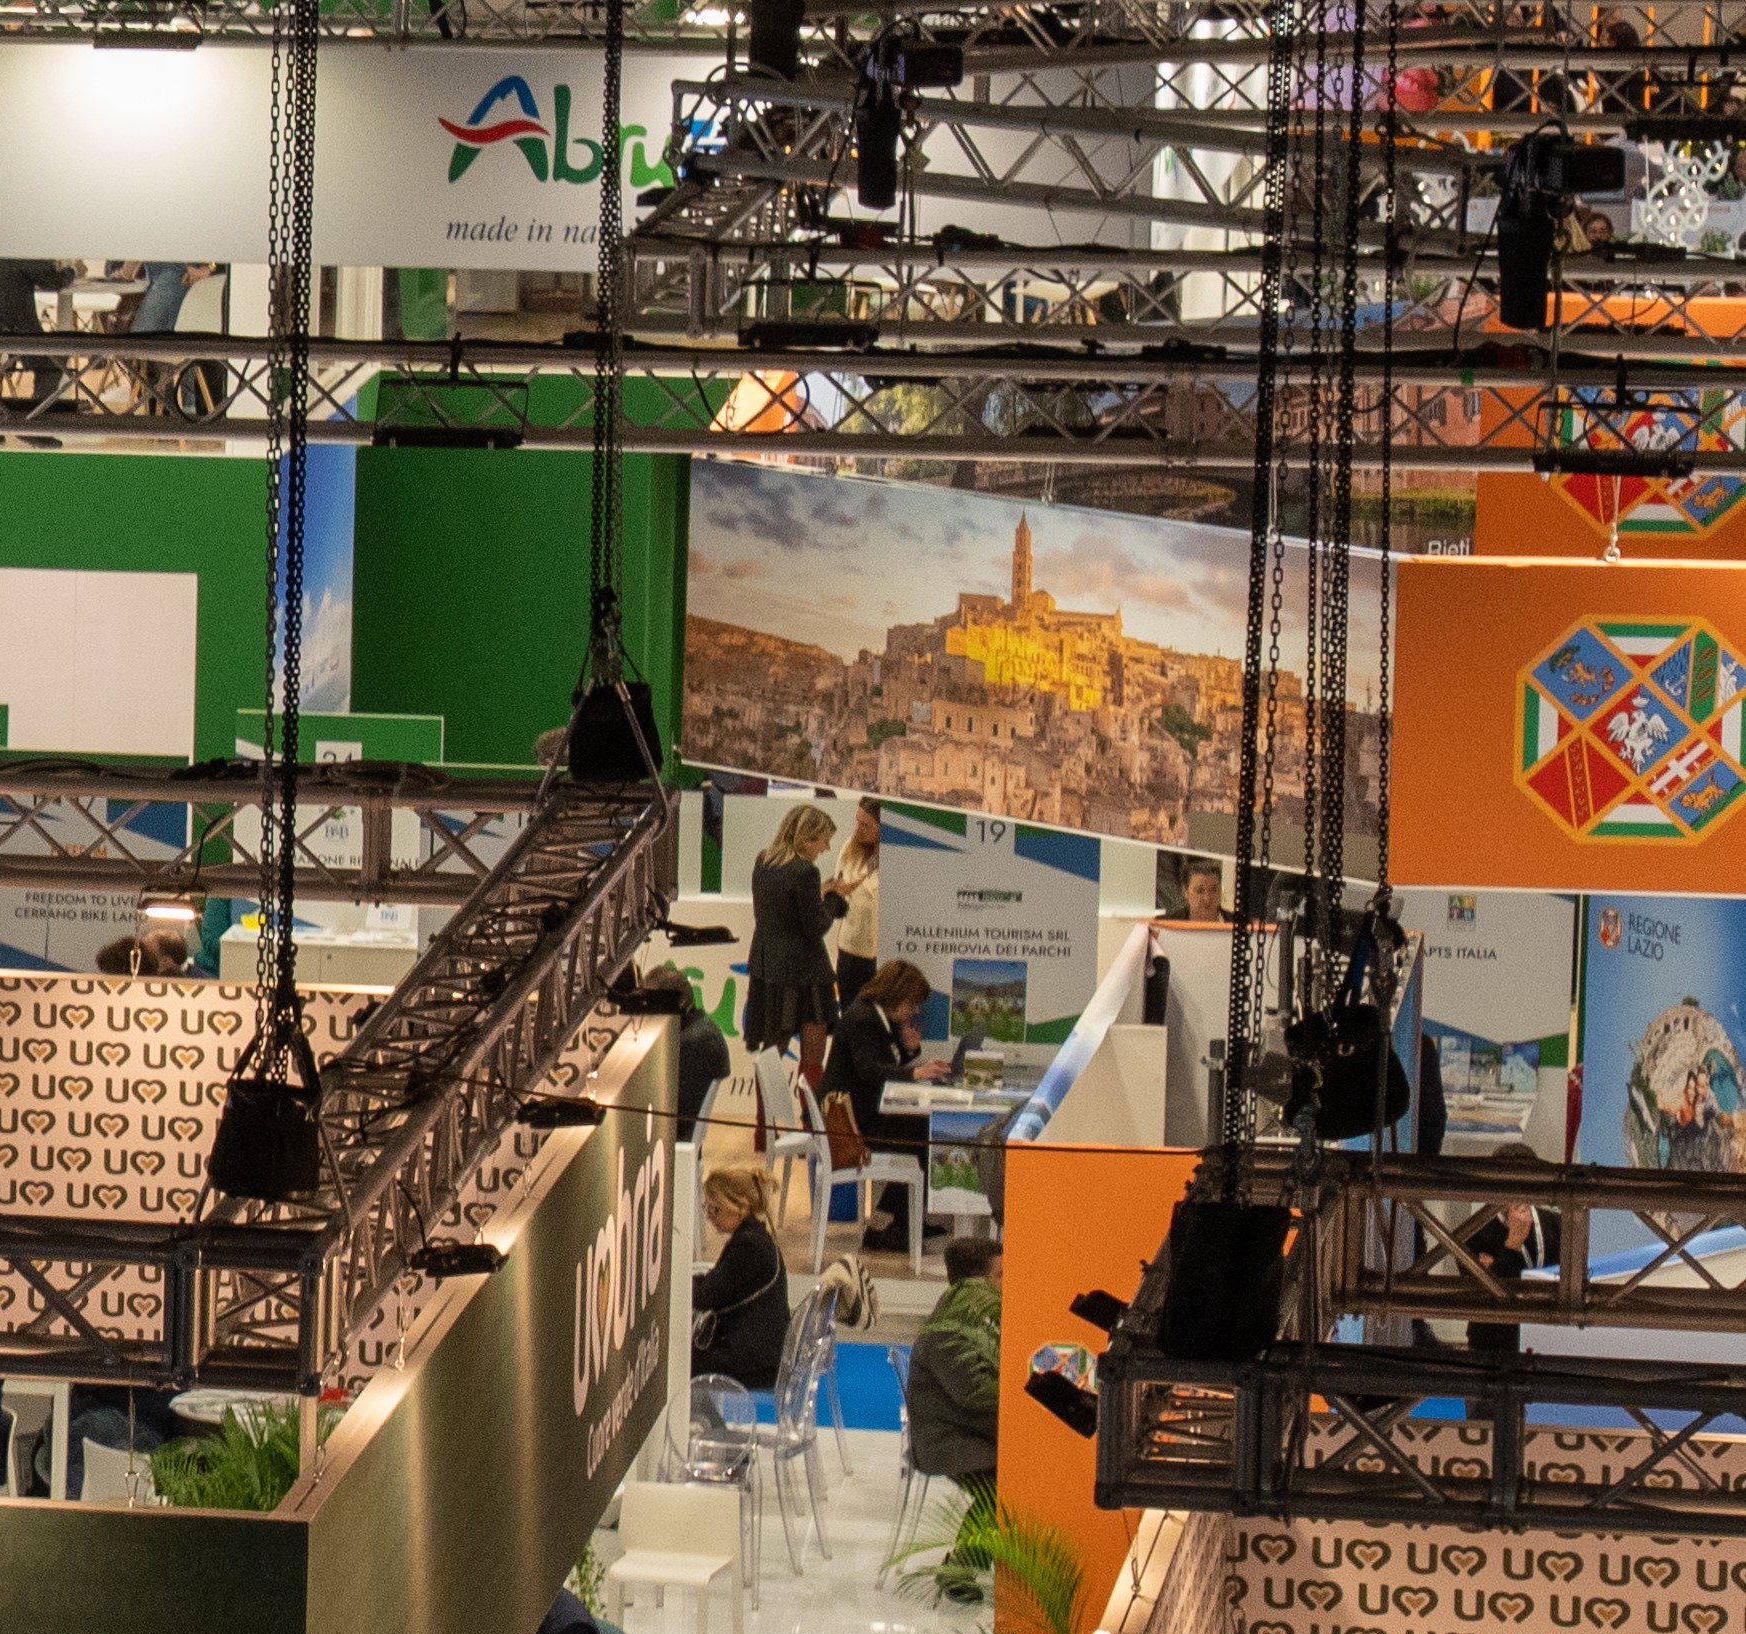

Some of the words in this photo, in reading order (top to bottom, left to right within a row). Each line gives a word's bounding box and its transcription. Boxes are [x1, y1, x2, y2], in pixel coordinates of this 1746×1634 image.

[446, 215, 519, 243] made
[528, 217, 553, 243] in
[976, 820, 1007, 843] 19
[25, 892, 87, 906] FREEDOM
[91, 894, 106, 907] TO
[14, 907, 76, 921] CERRANO
[80, 909, 108, 922] BIKE
[905, 925, 980, 939] PALLENIUM
[984, 927, 1044, 941] TOURISM
[1628, 913, 1681, 945] REGIONE
[925, 942, 993, 956] FERROVIA
[996, 944, 1017, 957] DEI
[1021, 945, 1071, 958] PARCHI
[1456, 947, 1497, 960] ITALIA
[1628, 938, 1665, 960] LAZIO
